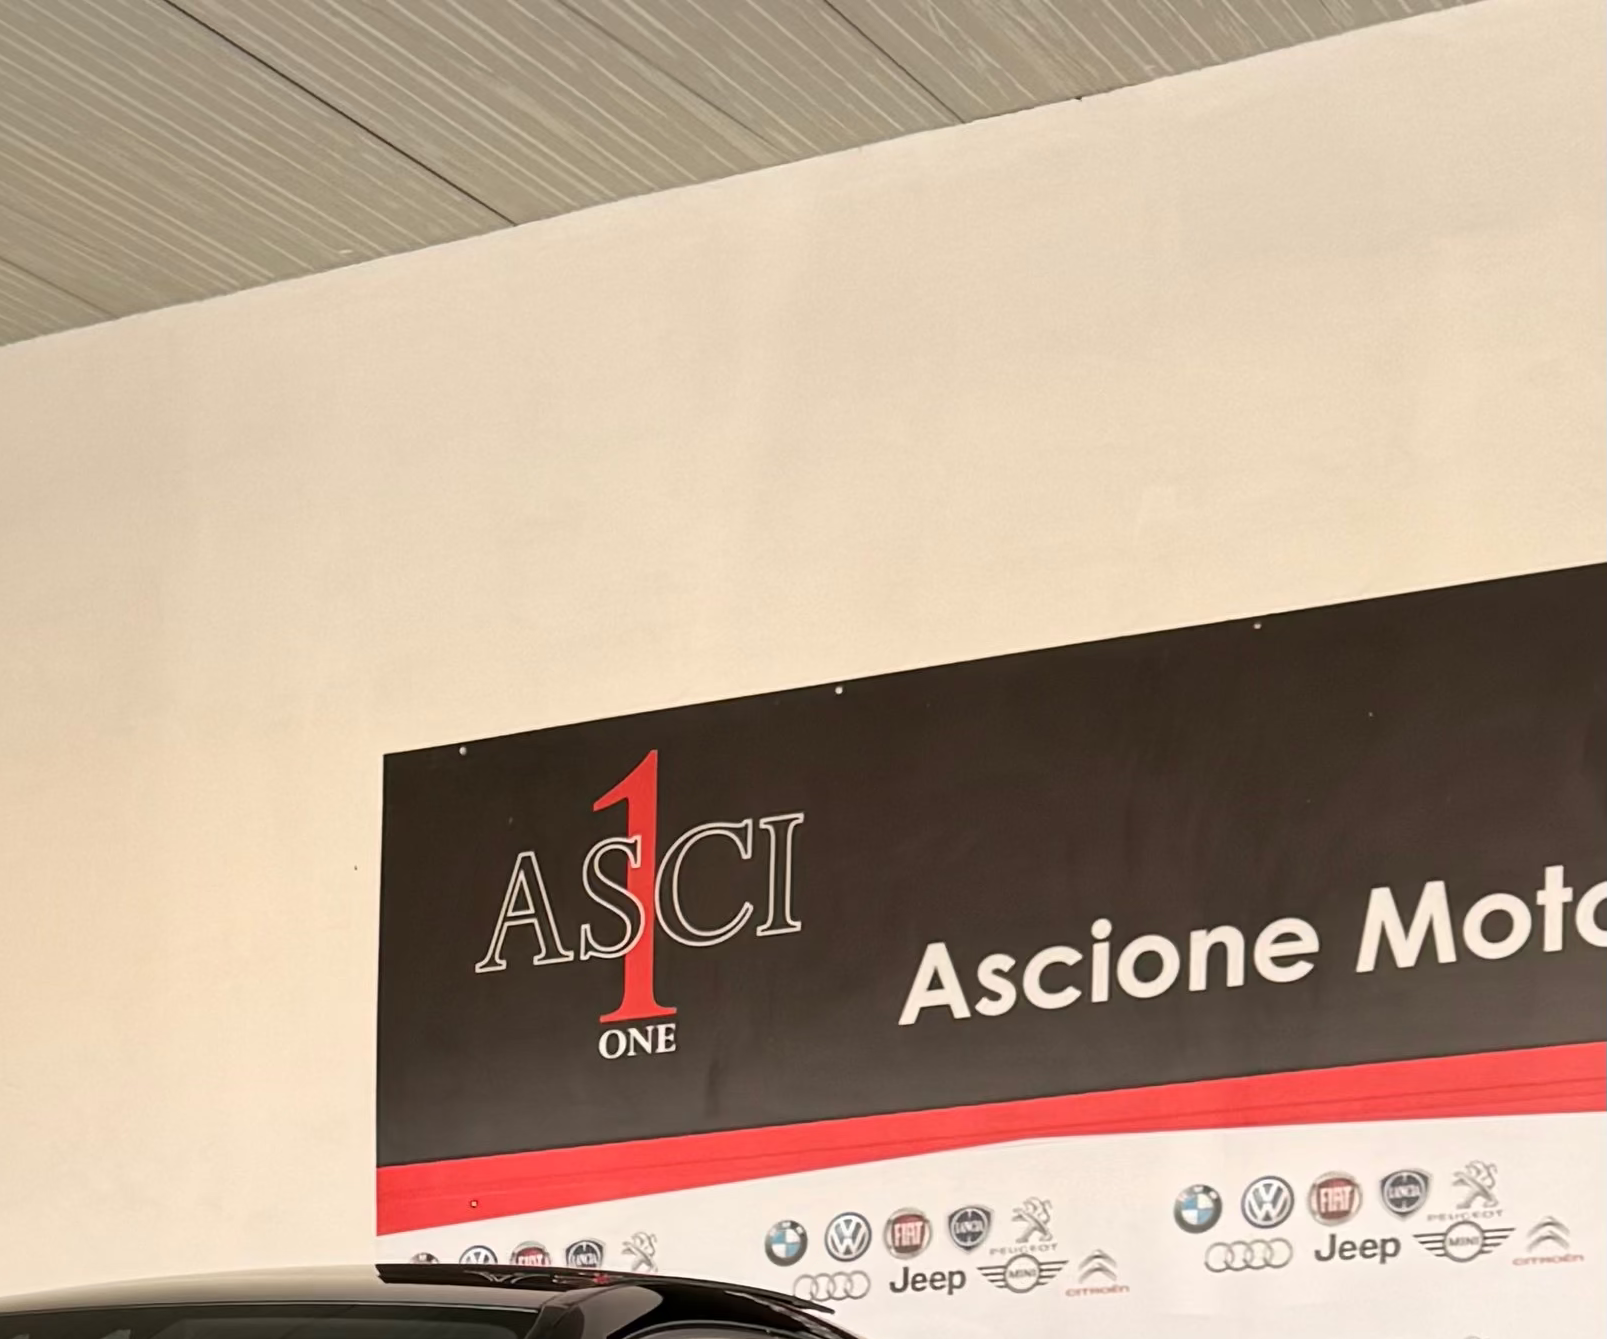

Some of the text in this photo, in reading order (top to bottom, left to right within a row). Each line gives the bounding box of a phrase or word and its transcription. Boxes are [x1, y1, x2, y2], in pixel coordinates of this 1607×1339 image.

[475, 812, 805, 974] ASCI
[898, 918, 1320, 1026] Ascione
[598, 1024, 678, 1060] ONE
[1319, 1186, 1353, 1213] FIAT
[893, 1221, 924, 1247] FIAT
[1314, 1233, 1401, 1265] Jeep
[1448, 1237, 1480, 1247] MINI
[889, 1266, 967, 1296] Jeep
[1008, 1267, 1037, 1279] MINI
